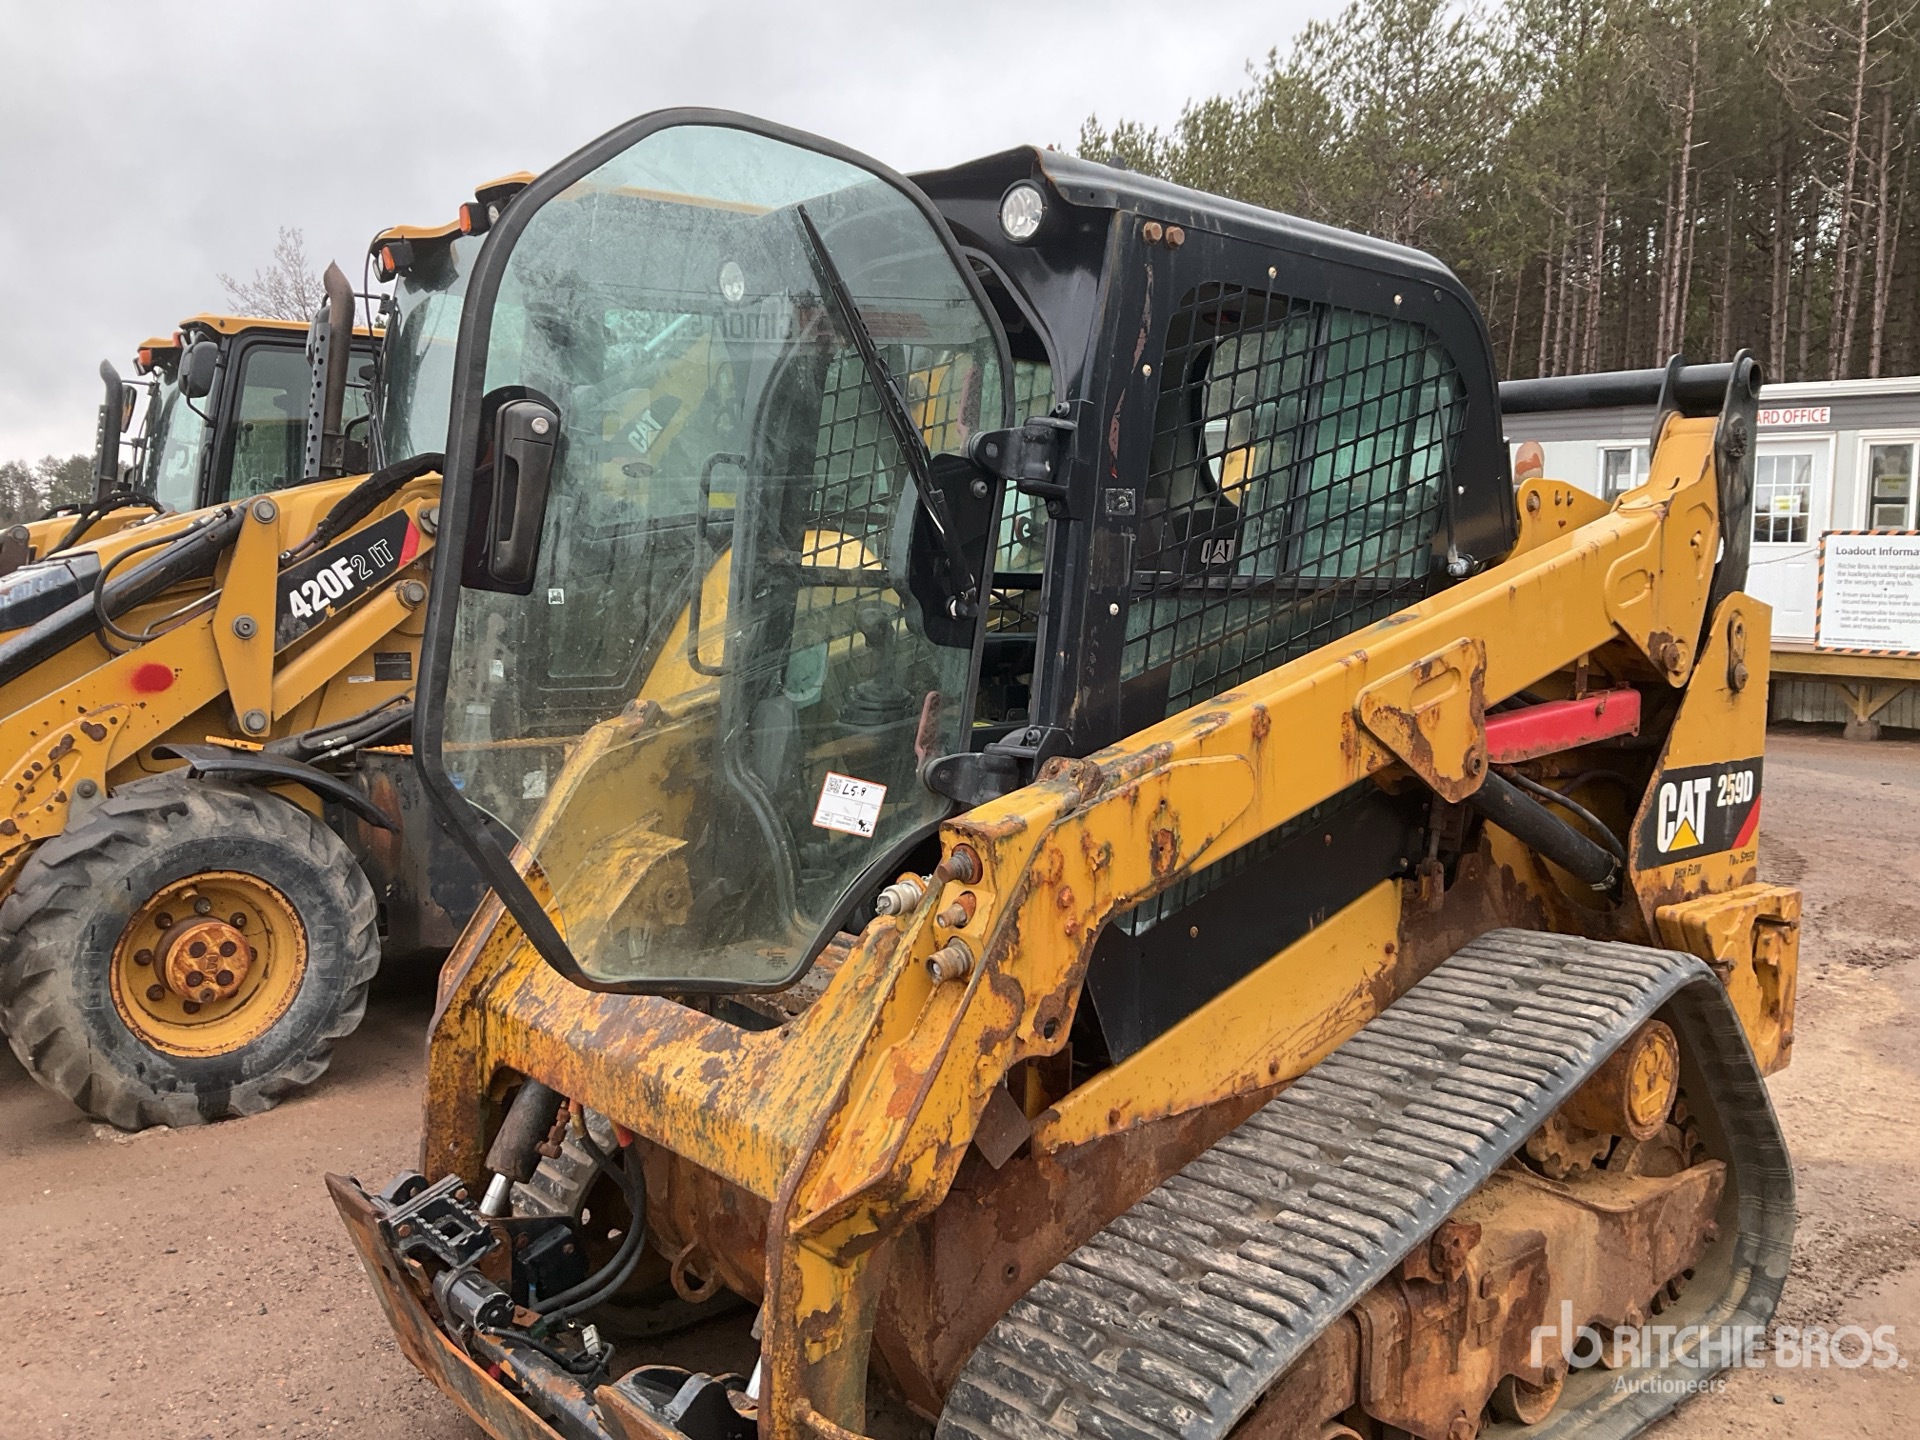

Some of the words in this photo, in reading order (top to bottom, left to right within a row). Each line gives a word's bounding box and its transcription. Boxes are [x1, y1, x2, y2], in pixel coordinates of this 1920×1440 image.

[1756, 410, 1780, 424] ARD
[1783, 408, 1828, 424] OFFICE
[628, 409, 662, 454] CAT
[1836, 546, 1876, 556] Loadout
[1879, 546, 1920, 556] Informa
[1657, 777, 1711, 853] CAT
[1717, 770, 1753, 807] 259D
